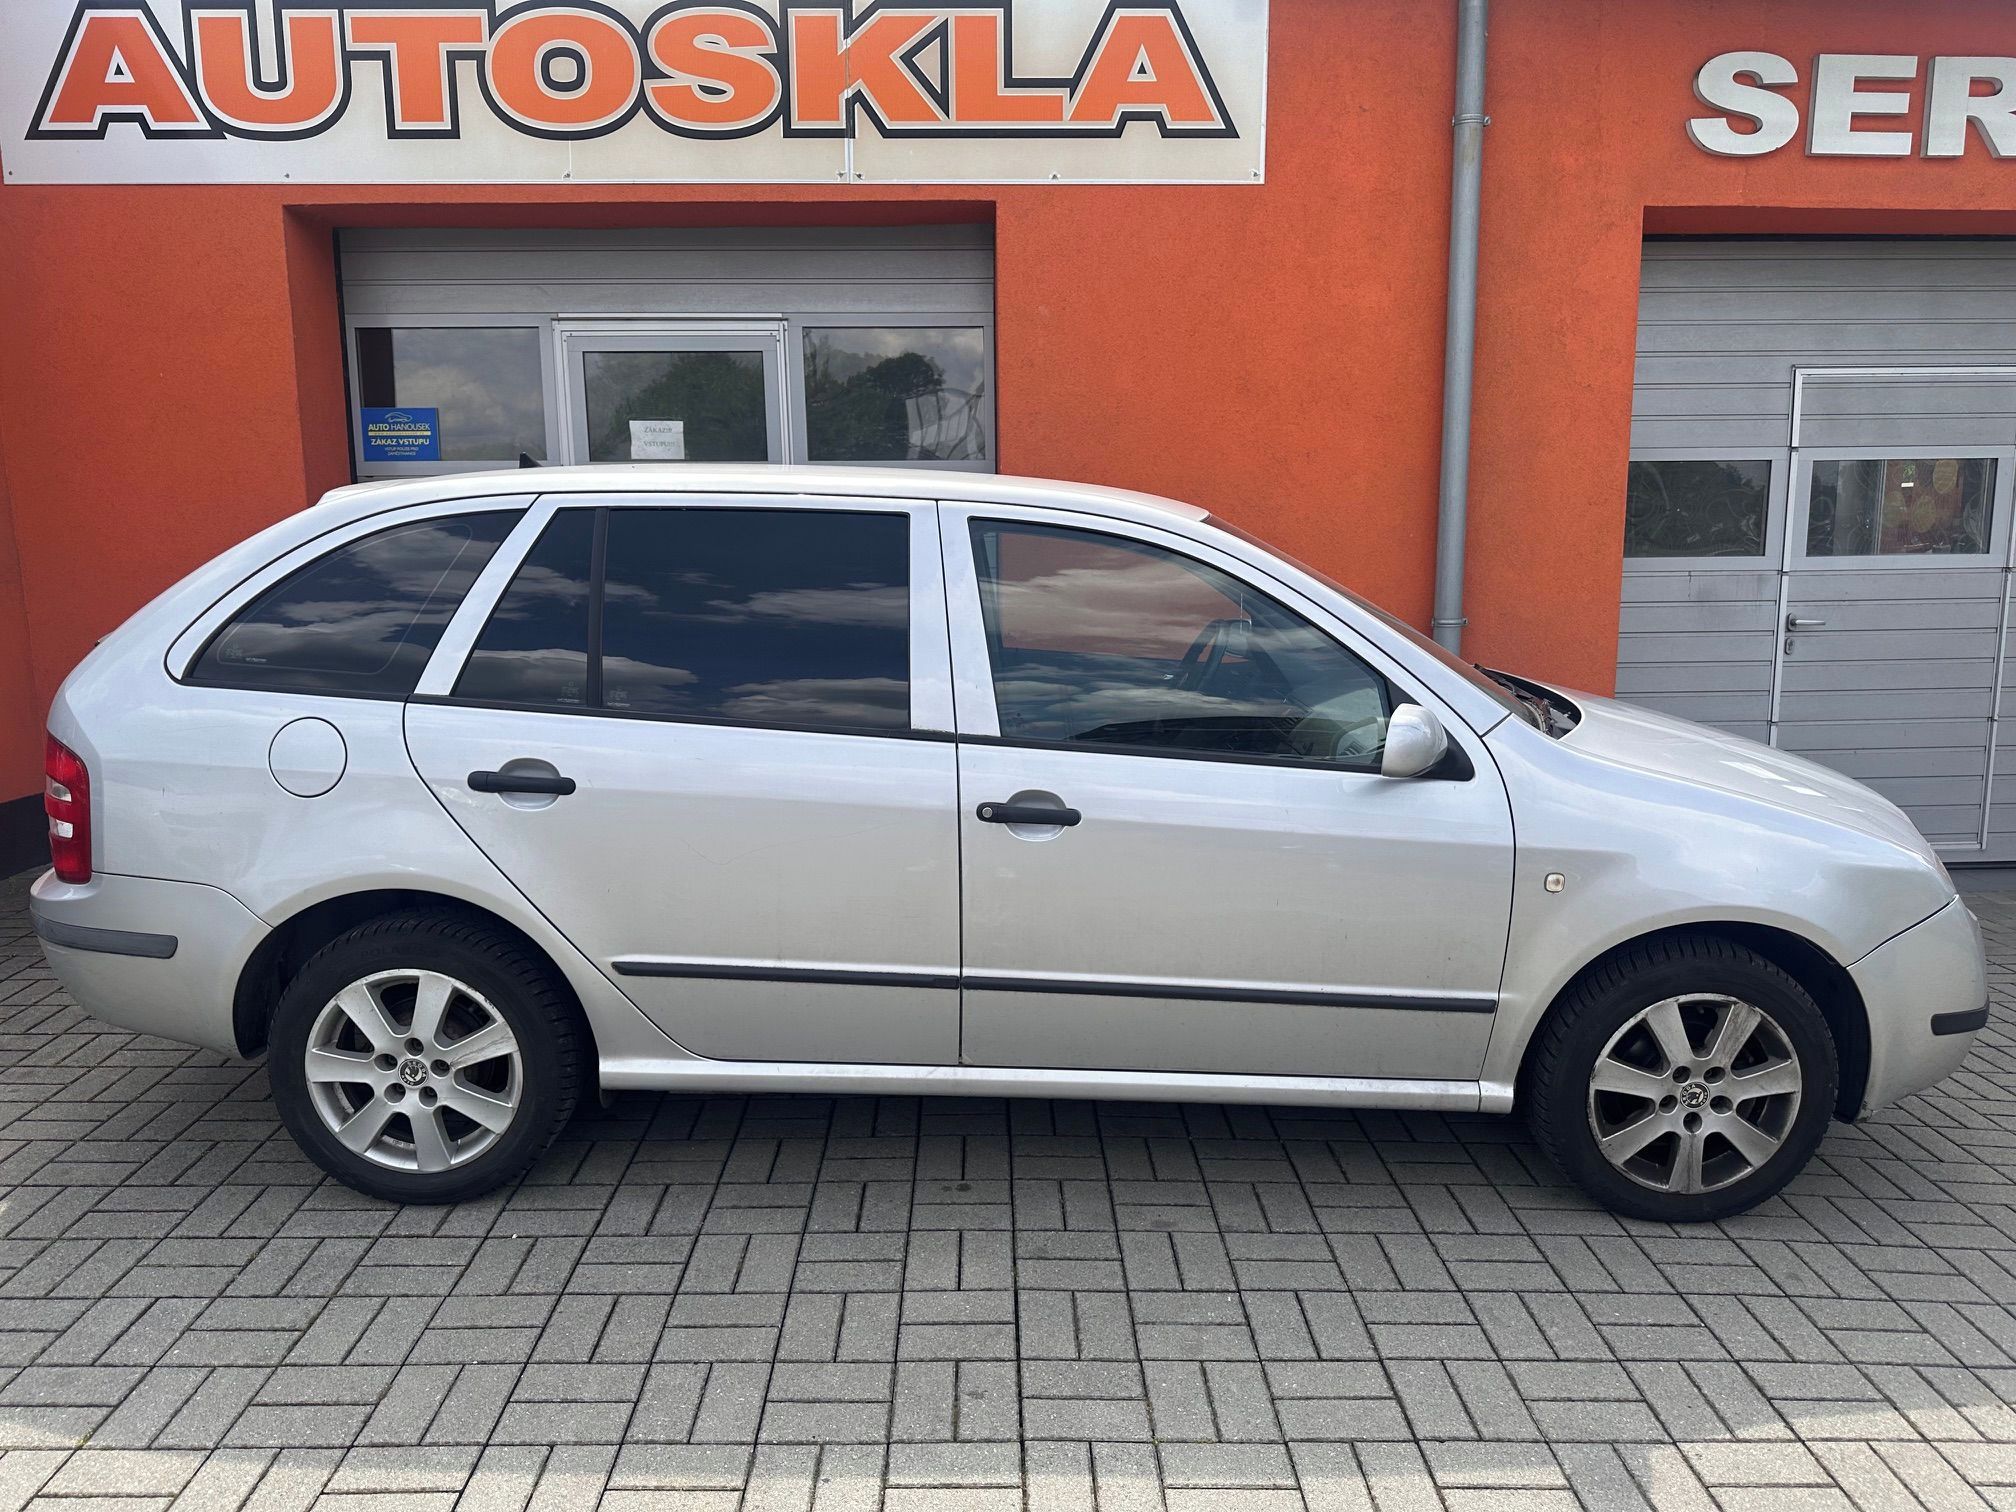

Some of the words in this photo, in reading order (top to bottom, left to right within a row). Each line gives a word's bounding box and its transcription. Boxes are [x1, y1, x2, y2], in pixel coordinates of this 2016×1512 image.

[26, 0, 1238, 140] AUTOSKLA
[1687, 51, 2016, 159] SER
[368, 423, 389, 431] AUTO
[391, 423, 430, 431] HANOUSEK
[371, 437, 398, 446] ZÁKAZ
